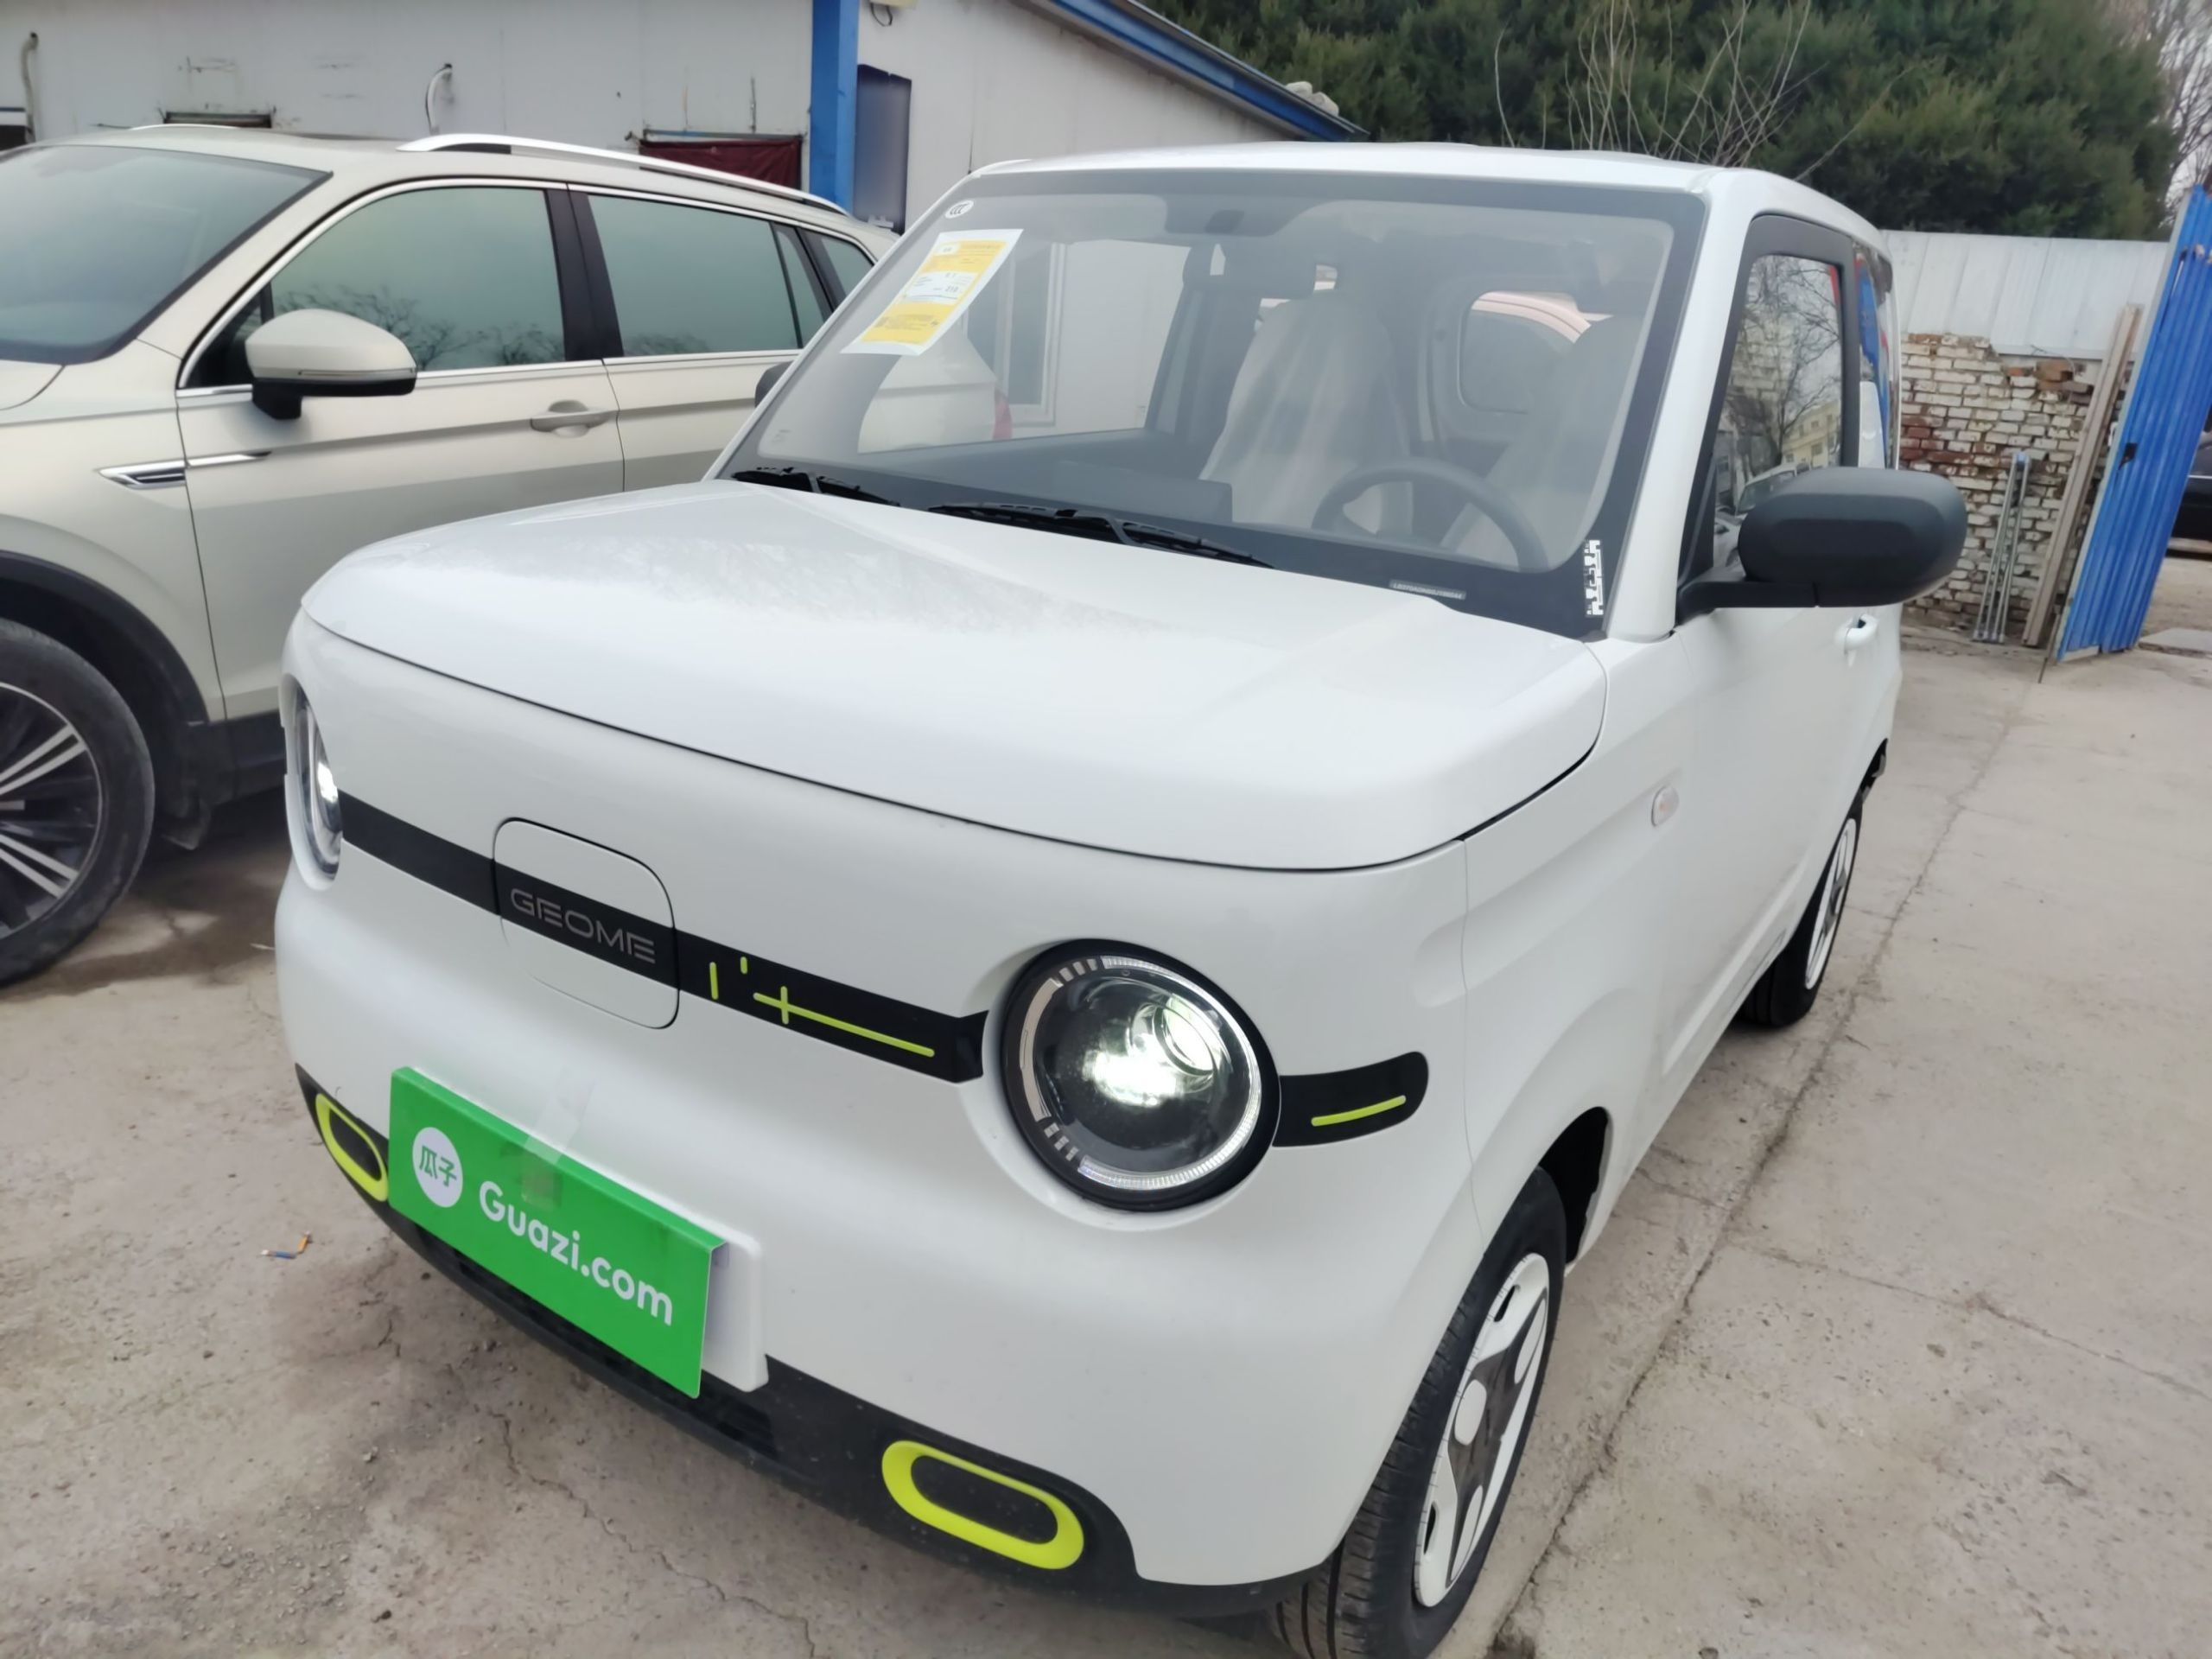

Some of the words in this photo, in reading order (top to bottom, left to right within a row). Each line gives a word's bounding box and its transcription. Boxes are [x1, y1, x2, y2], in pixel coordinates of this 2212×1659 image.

[510, 888, 656, 964] GEOME
[418, 1145, 458, 1187] 瓜子
[479, 1180, 673, 1326] Guazi.com
